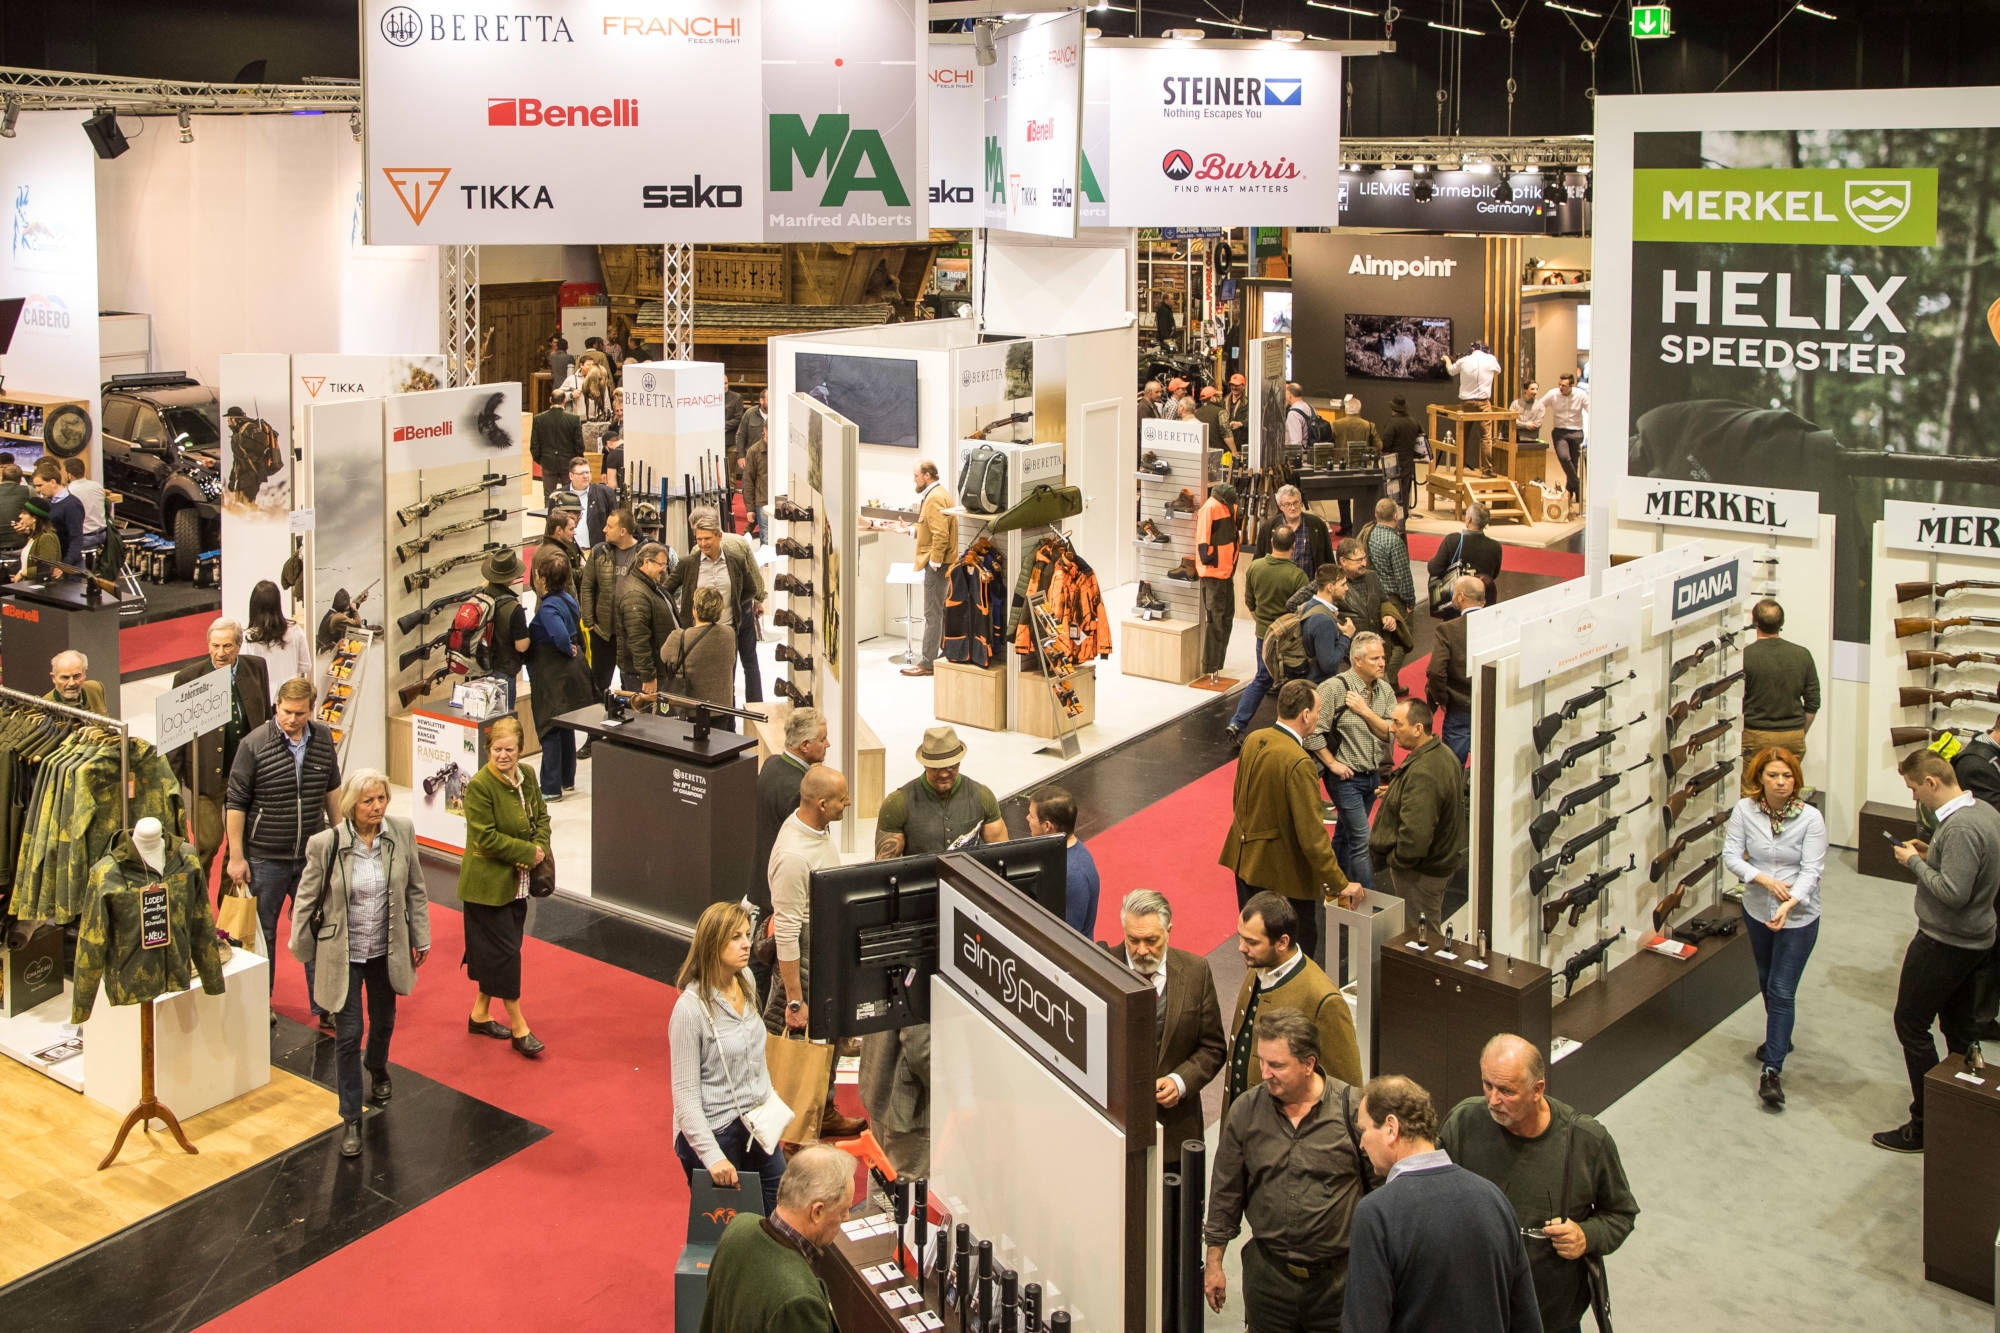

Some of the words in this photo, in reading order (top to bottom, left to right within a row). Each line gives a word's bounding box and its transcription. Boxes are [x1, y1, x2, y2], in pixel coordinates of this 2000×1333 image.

[430, 14, 575, 43] BERETTA
[603, 16, 741, 37] FRANCHI
[1163, 76, 1262, 106] STEINER
[518, 98, 639, 128] Benelli
[1163, 108, 1201, 120] Nothing
[1203, 108, 1243, 120] Escapes
[1245, 108, 1262, 119] You
[1031, 118, 1054, 142] Benelli
[769, 113, 911, 207] MA
[1195, 153, 1301, 180] Burris
[460, 185, 555, 210] TIKKA
[643, 174, 742, 209] sako
[1052, 178, 1072, 208] sako
[1174, 185, 1200, 193] FIND
[1205, 185, 1234, 193] WHAT
[1239, 185, 1289, 193] MATTERS
[1359, 182, 1411, 197] LIEMKE
[1476, 201, 1535, 216] Germany
[1662, 190, 1839, 222] MERKEL
[769, 213, 842, 227] Manfred
[847, 212, 912, 227] Alberts
[1348, 254, 1457, 281] Aimpoint
[1662, 269, 1908, 334] HELIX
[23, 307, 70, 329] CABERO
[1660, 334, 1907, 376] SPEEDSTER
[972, 368, 1004, 384] BERETTA
[330, 383, 365, 393] TIKKA
[625, 391, 674, 409] BERETTA
[676, 393, 723, 409] FRANCHI
[405, 420, 453, 441] Benelli
[1158, 430, 1200, 444] BERETTA
[1032, 455, 1062, 471] BERETTA
[1645, 490, 1788, 528] MERKEL
[1677, 570, 1733, 611] DIANA
[417, 719, 446, 729] NEWSLETTER
[417, 745, 451, 763] RANGER
[680, 771, 707, 785] BERETTA
